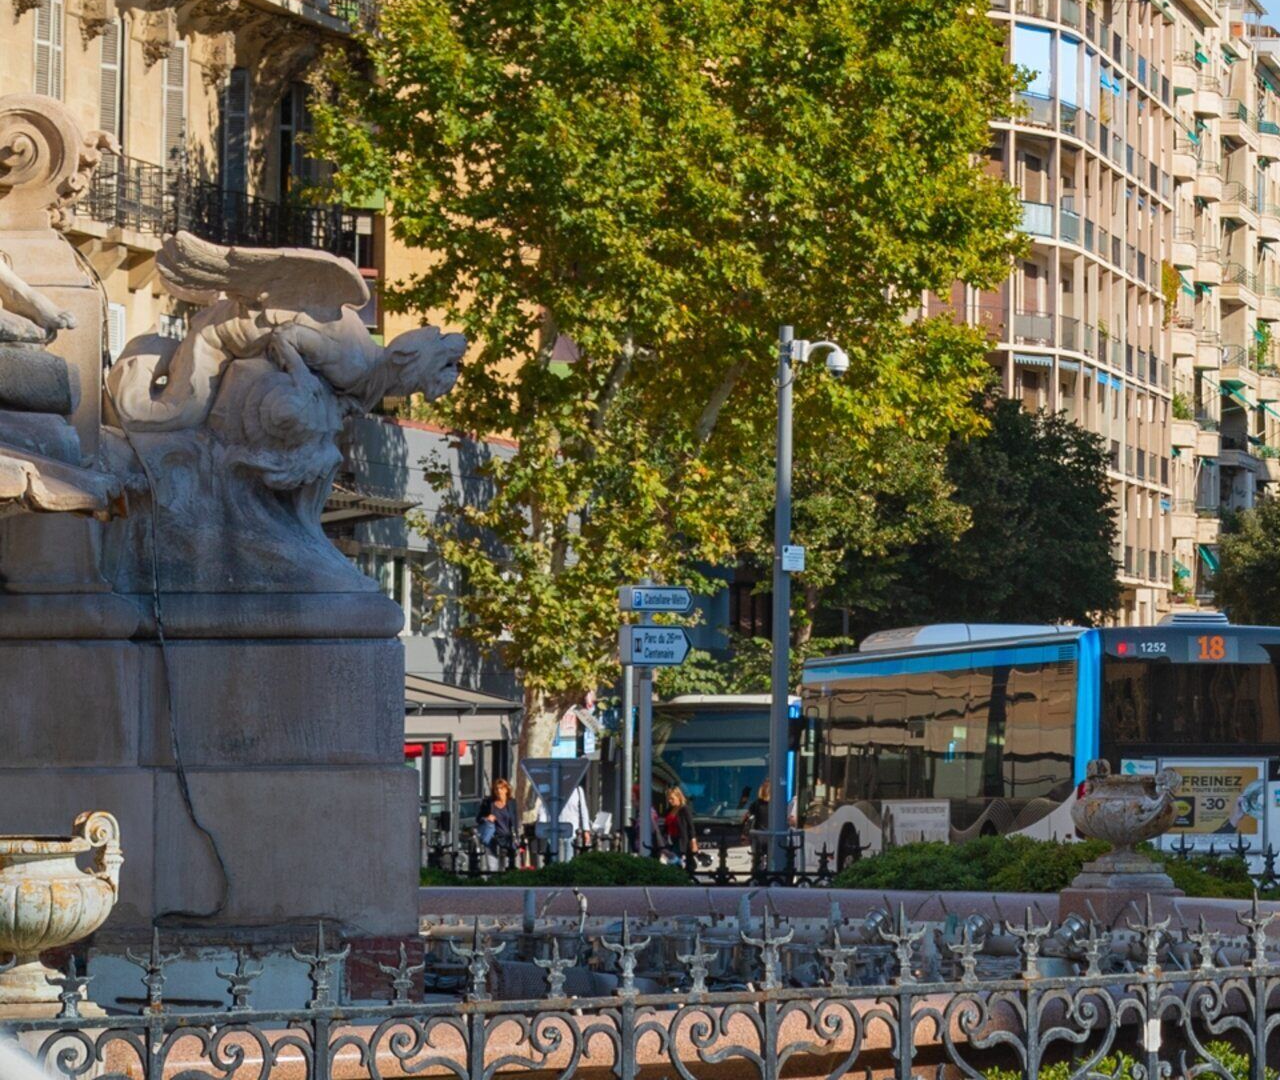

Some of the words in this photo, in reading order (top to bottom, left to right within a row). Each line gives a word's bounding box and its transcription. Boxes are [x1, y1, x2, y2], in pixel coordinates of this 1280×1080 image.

[1140, 642, 1167, 653] 1252
[1197, 635, 1226, 660] 18
[1182, 776, 1243, 787] FREINEZ
